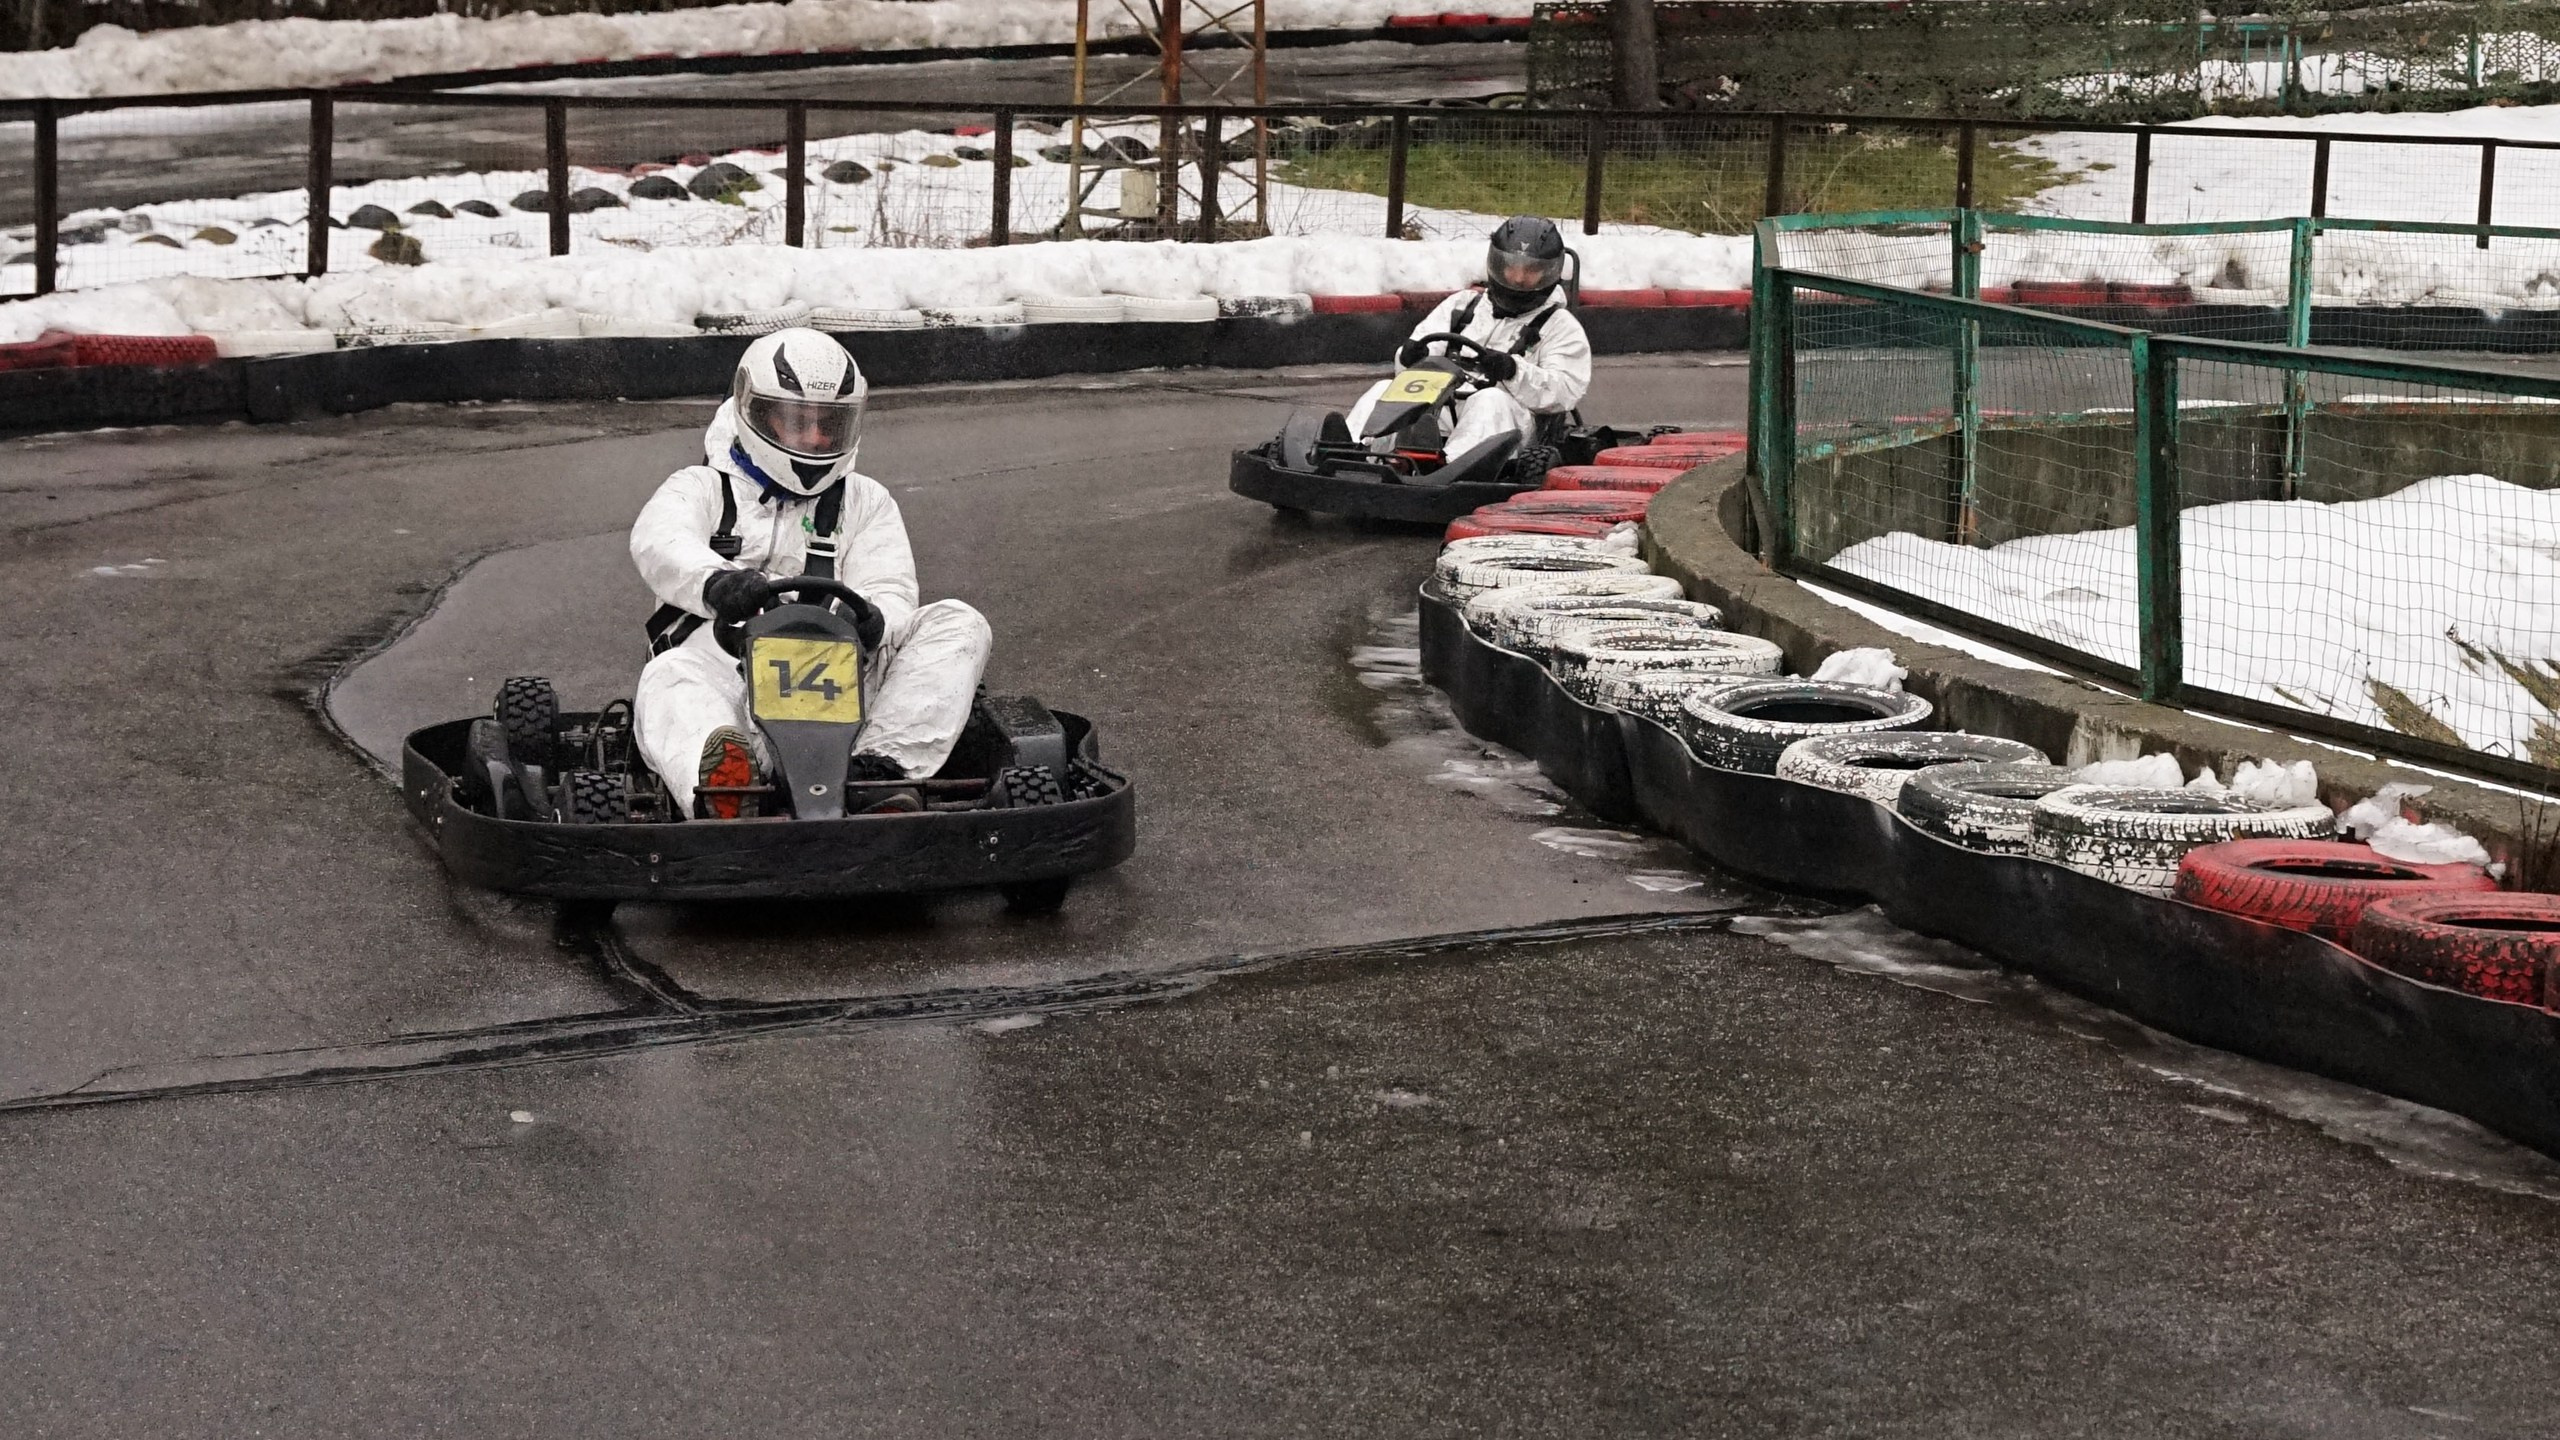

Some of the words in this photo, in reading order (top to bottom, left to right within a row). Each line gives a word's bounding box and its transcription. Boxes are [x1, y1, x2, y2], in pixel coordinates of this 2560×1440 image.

[806, 381, 837, 391] HIZER
[1404, 379, 1429, 394] 6
[768, 659, 843, 701] 14
